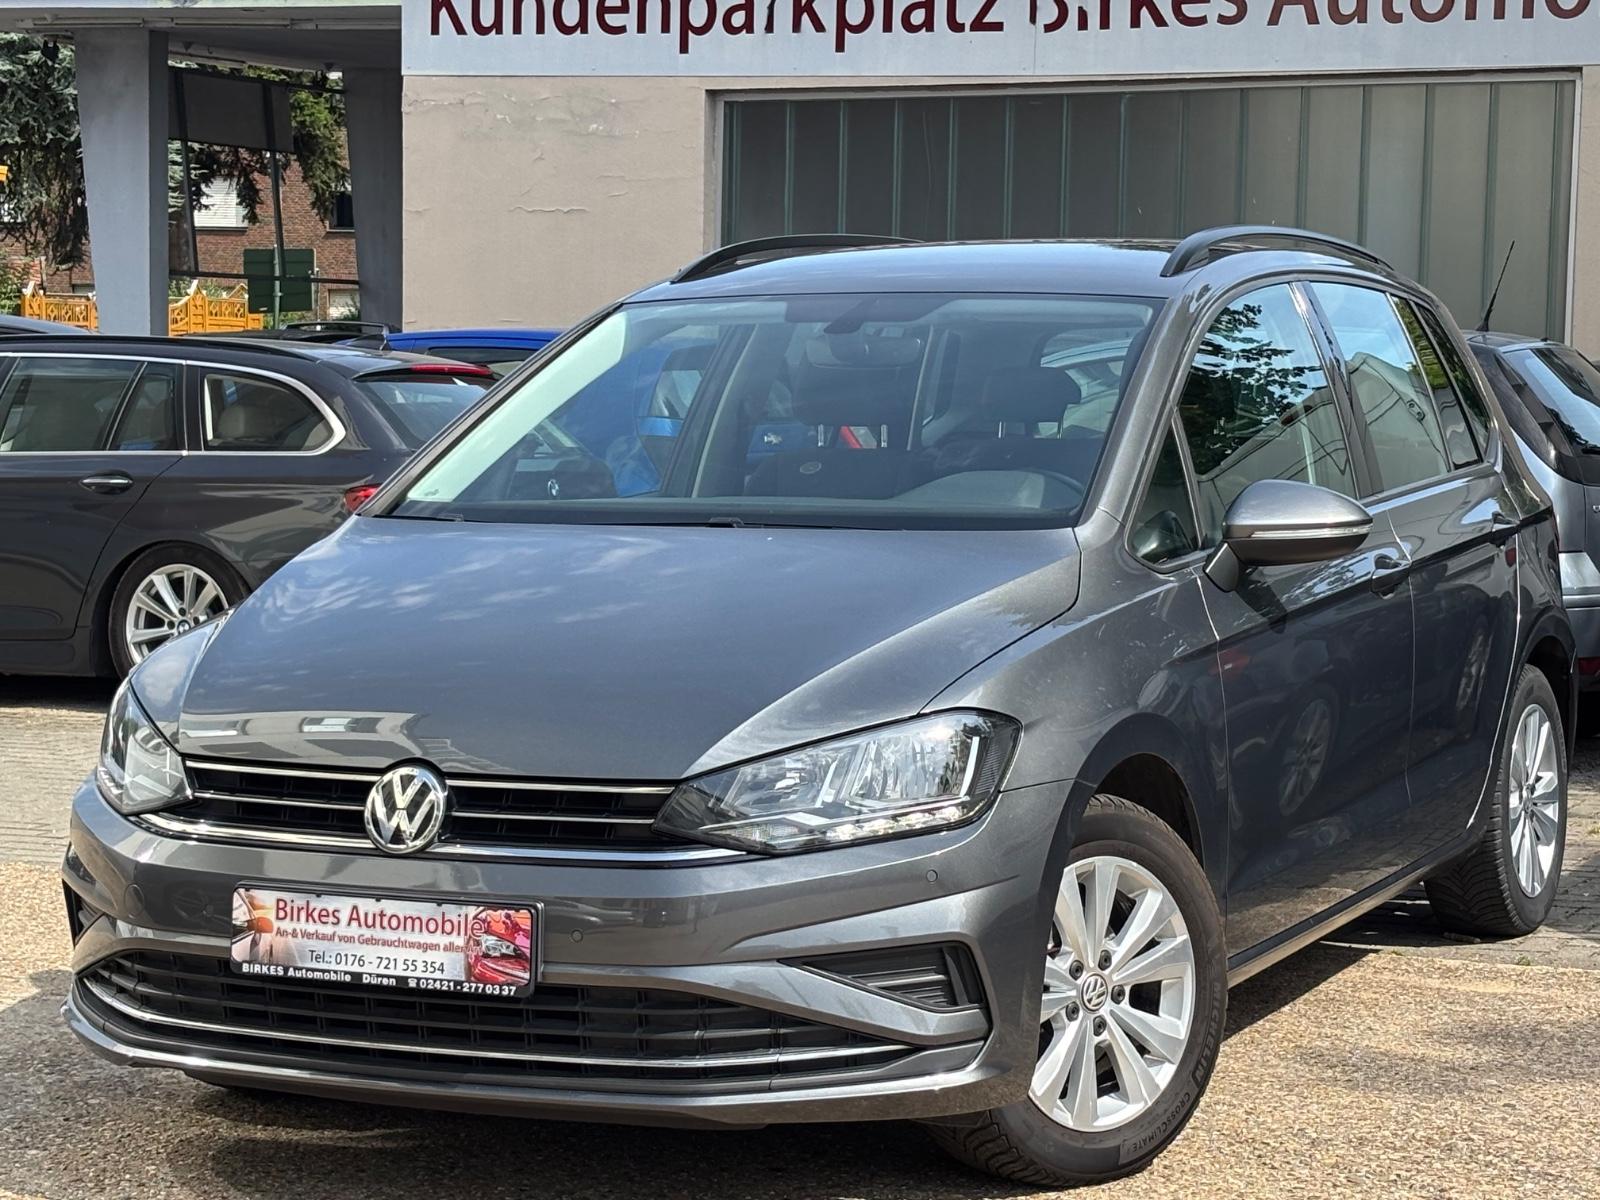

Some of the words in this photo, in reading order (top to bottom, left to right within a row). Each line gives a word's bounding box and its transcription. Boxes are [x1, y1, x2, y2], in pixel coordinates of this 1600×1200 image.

[275, 898, 341, 926] Birkes
[347, 904, 485, 938] Automobile
[300, 928, 336, 942] Verkauf
[338, 934, 355, 943] von
[357, 934, 441, 953] Gebrauchtwagen
[241, 962, 284, 976] BIRKES
[287, 967, 352, 982] Automobile
[362, 973, 397, 986] Düren
[308, 949, 332, 964] Tel.:
[334, 952, 366, 968] 0176
[376, 956, 398, 970] 721
[401, 958, 418, 972] 55
[420, 959, 446, 974] 354
[1191, 981, 1221, 1086] MICHELIN
